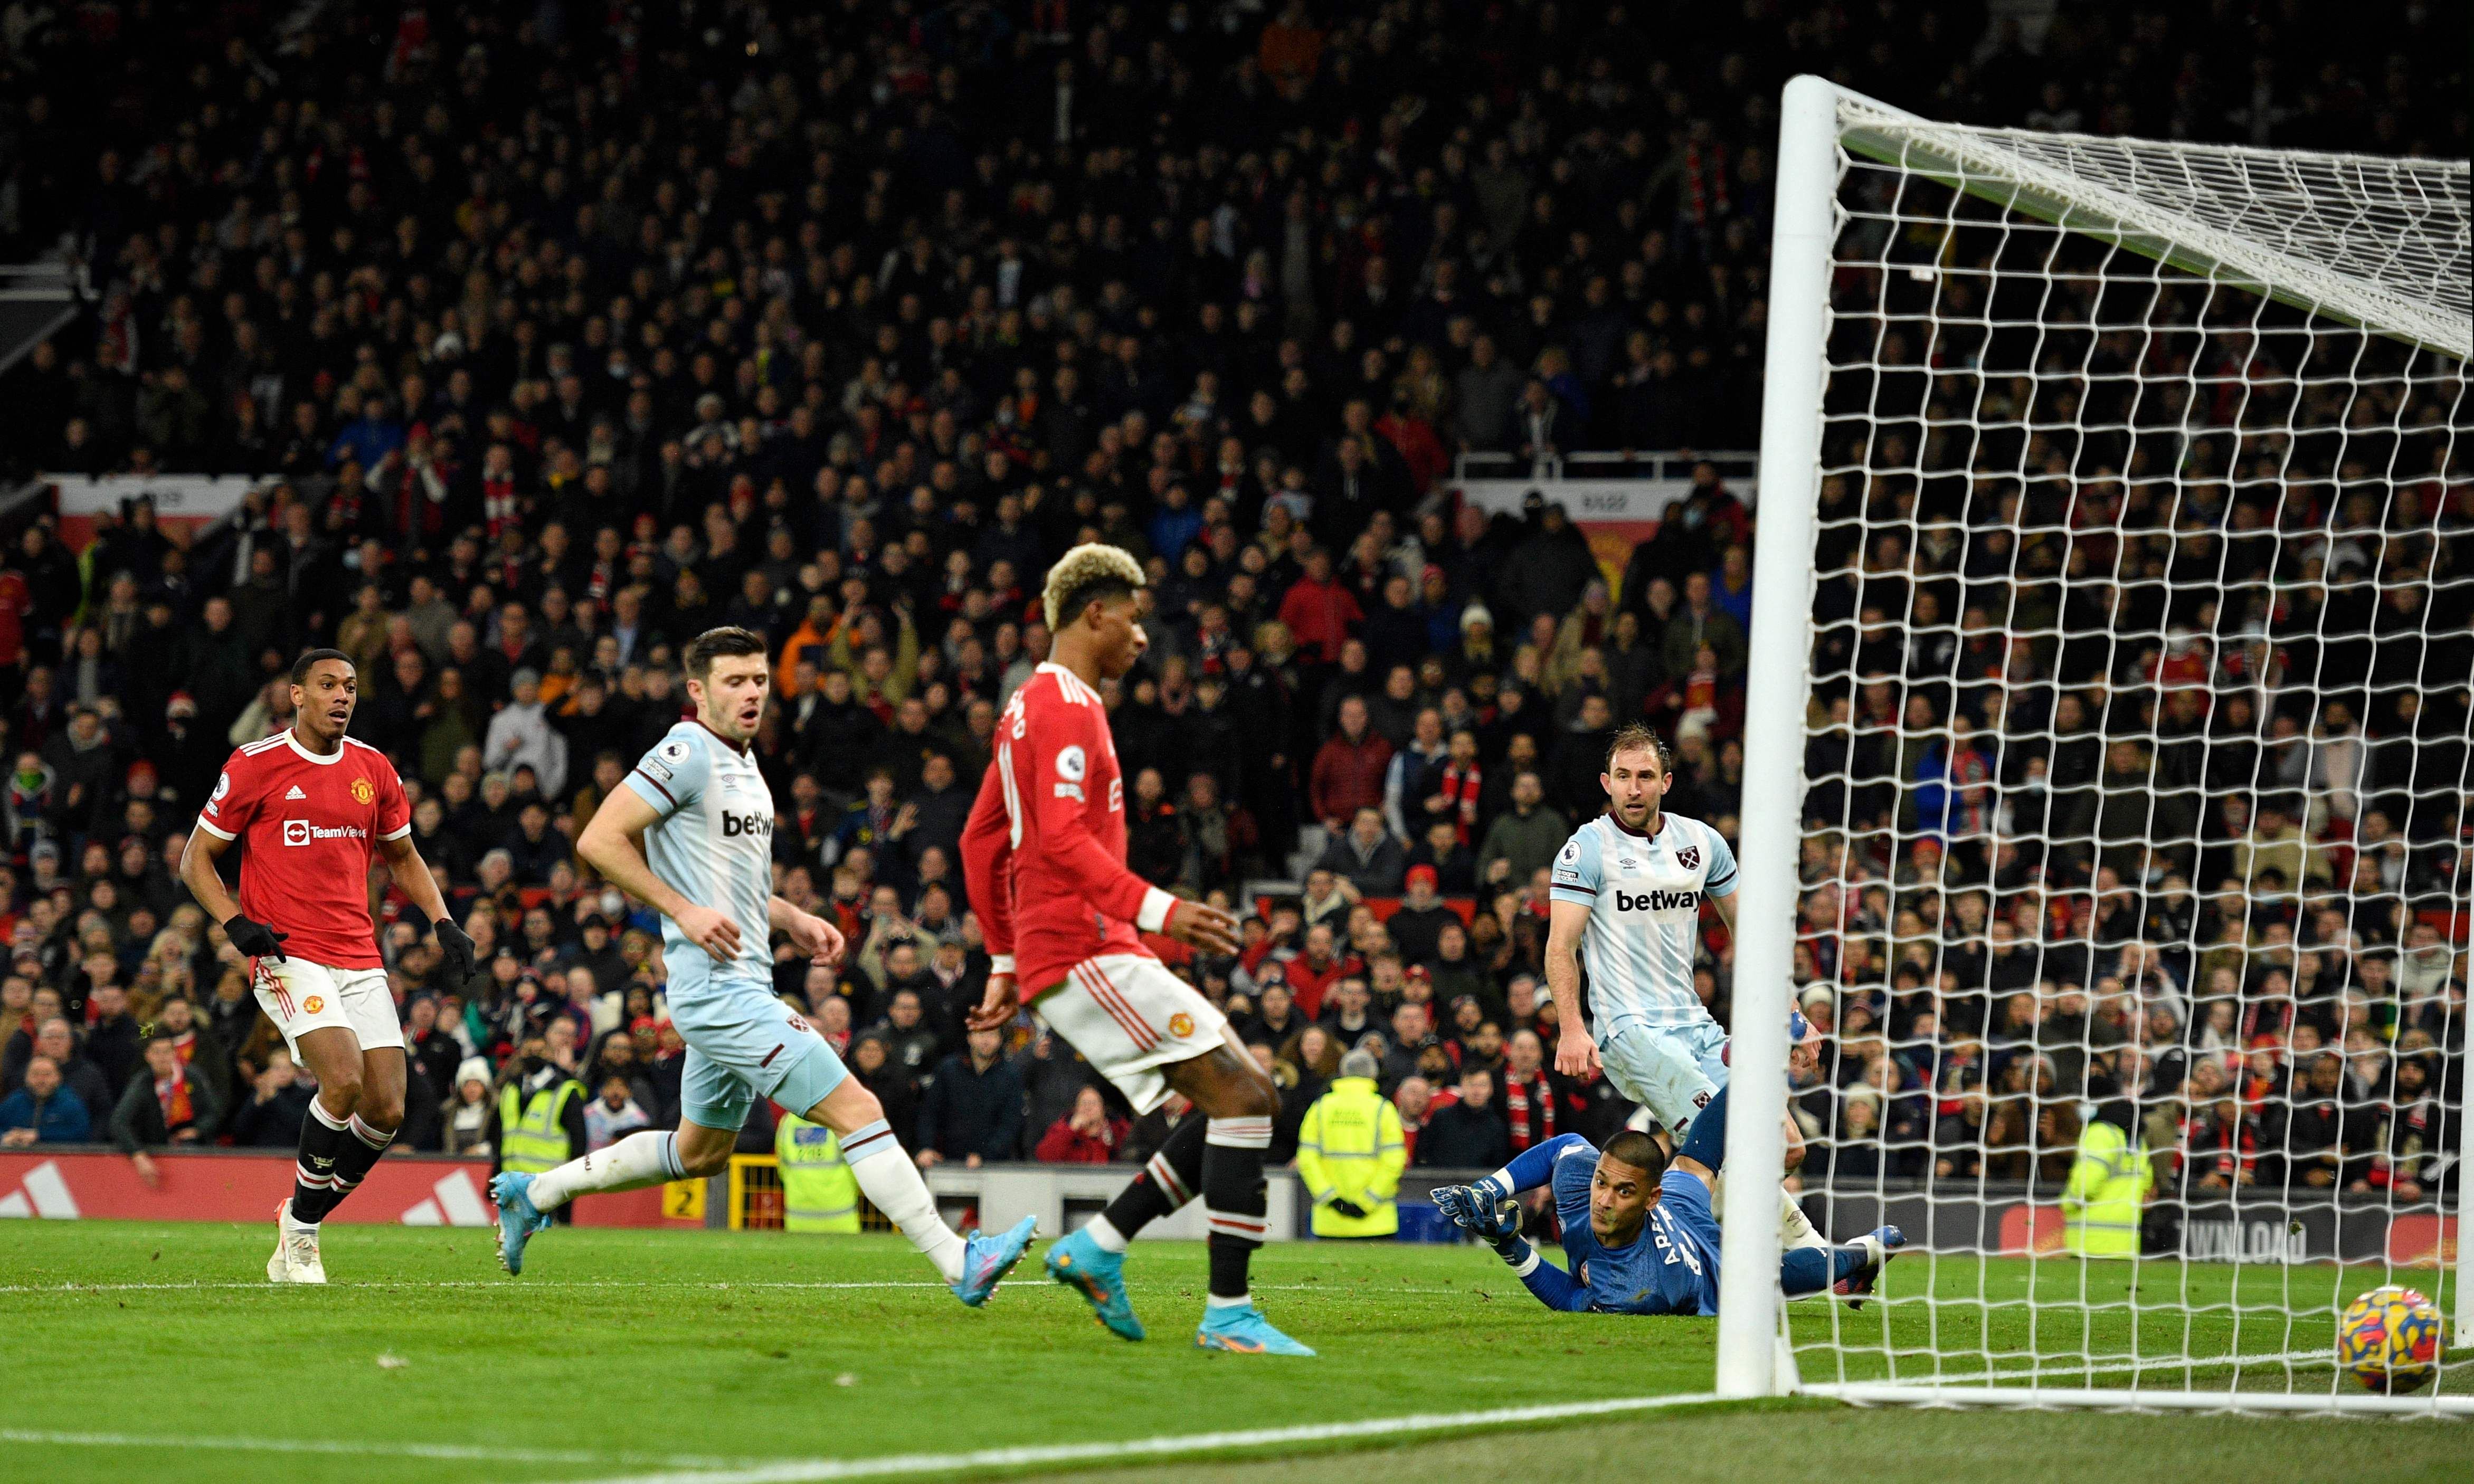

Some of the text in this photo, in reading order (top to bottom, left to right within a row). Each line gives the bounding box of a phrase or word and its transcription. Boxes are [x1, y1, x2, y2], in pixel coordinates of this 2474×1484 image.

[310, 825, 367, 839] TeamViewe
[722, 810, 774, 836] betw
[1616, 890, 1701, 912] betway
[676, 1191, 693, 1216] 2
[1650, 1210, 1681, 1265] ARE
[2175, 1220, 2307, 1264] WNLOAD
